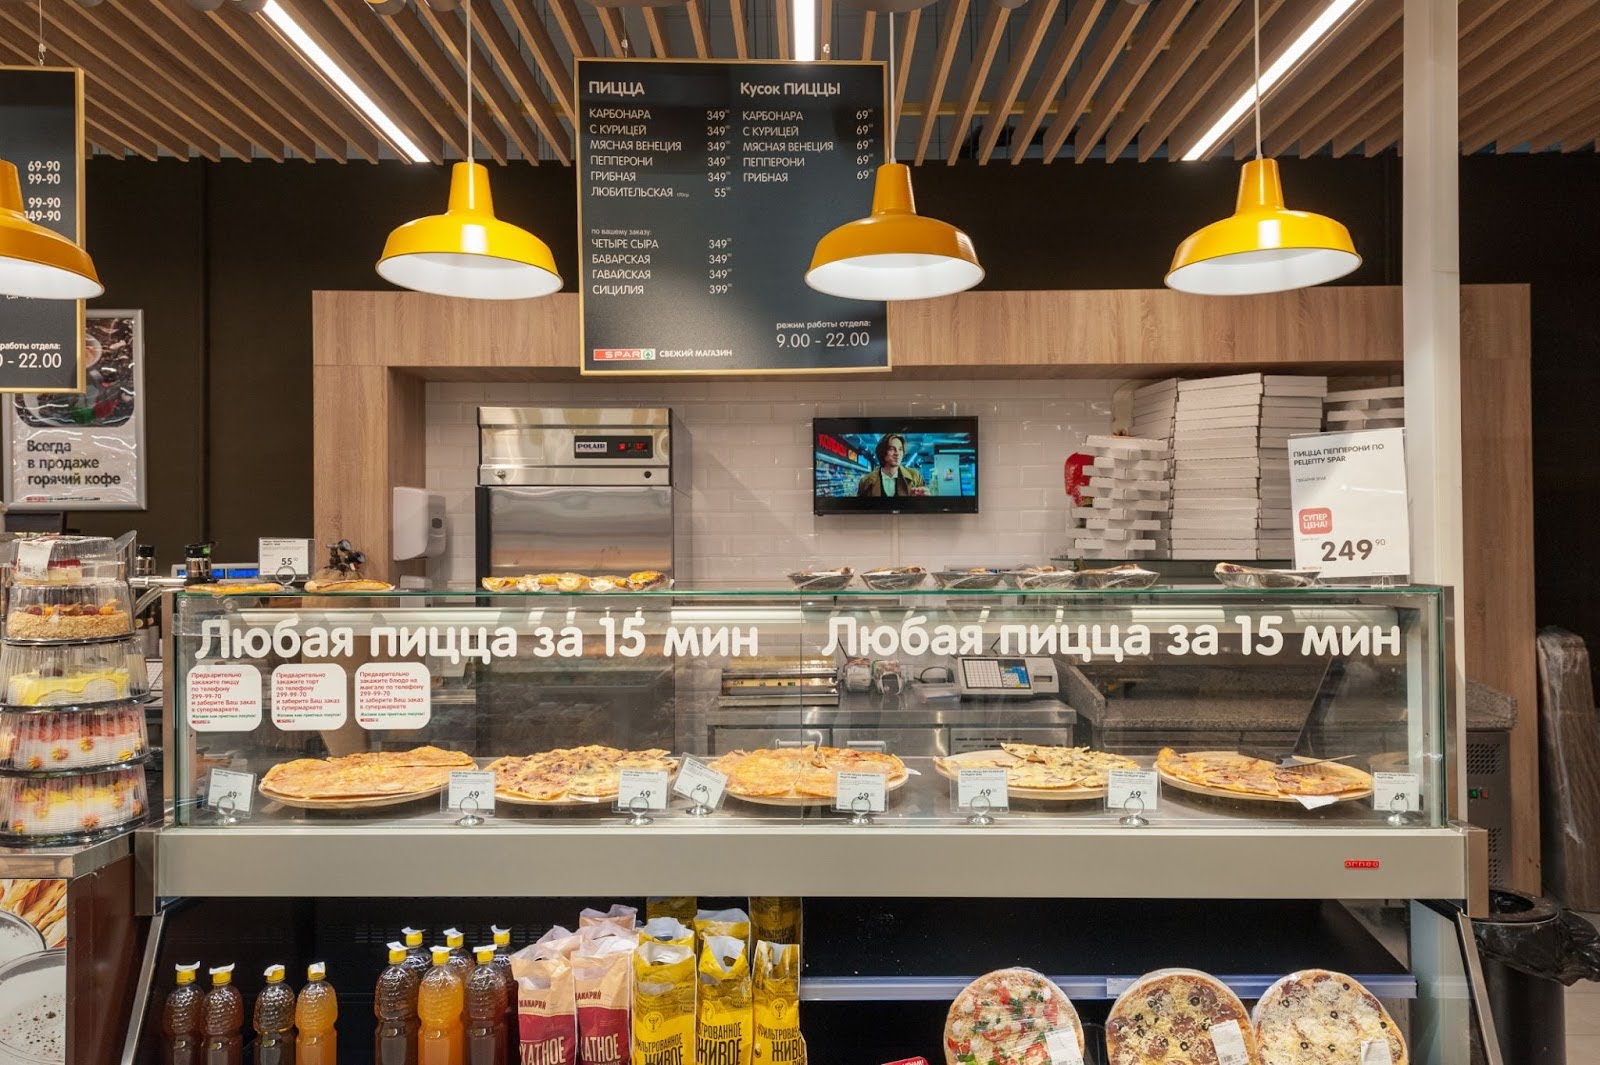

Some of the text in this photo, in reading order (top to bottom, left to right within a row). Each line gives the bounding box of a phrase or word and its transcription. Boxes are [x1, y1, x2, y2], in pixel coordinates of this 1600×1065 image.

[589, 81, 644, 96] ПИЦЦА
[740, 82, 840, 97] Кусок ПИЦЦЫ
[589, 109, 725, 120] КАРБОНАРА 349
[743, 110, 869, 121] КАРБОНАРА 69
[590, 125, 726, 136] С КУРИЦЕЙ 349
[743, 125, 869, 137] С КУРИЦЕЙ 69
[590, 141, 726, 152] МЯСНАЯ ВЕНЕЦИЯ 349
[743, 140, 869, 153] МЯСНАЯ ВЕНЕЦИЯ 69
[28, 161, 60, 171] 69-90
[591, 156, 726, 167] ПЕППЕРОНИ 349
[743, 155, 869, 167] ПЕППЕРОНИ 69
[28, 174, 60, 184] 99-90
[591, 172, 726, 182] ГРИБНАЯ 349
[743, 170, 870, 182] ГРИБНАЯ 69
[591, 187, 673, 197] ЛЮБИТЕЛЬСКАЯ
[714, 188, 726, 197] 55
[29, 198, 60, 208] 99-90
[592, 228, 599, 236] по
[601, 228, 627, 236] вашему
[592, 239, 727, 249] ЧЕТЫРЕ СЫРА 349
[592, 254, 728, 264] БАВАРСКАЯ 349
[593, 268, 728, 279] ГАВАЙСКАЯ 349
[593, 285, 728, 296] СИЦИЛИЯ 399
[777, 320, 871, 330] режим работы отдела:
[777, 334, 810, 347] 9.00
[826, 332, 870, 347] 22.00
[0, 342, 29, 351] работы
[659, 349, 732, 358] СВЕЖИЙ МАГАЗИН
[19, 353, 61, 368] 22.00
[27, 440, 71, 454] Всегда
[1324, 445, 1370, 455] ПЕППЕРОНИ
[28, 459, 99, 471] в продаже
[1294, 458, 1325, 466] РЕЦЕПТУ
[28, 473, 121, 488] горячий кофе
[1304, 522, 1327, 530] ЦЕНА!
[1321, 539, 1372, 562] 249
[195, 617, 759, 664] Любая пицца за 15 мин
[822, 616, 1401, 663] Любая пицца за 15 мин
[698, 1039, 742, 1065] ЖИВОЕ
